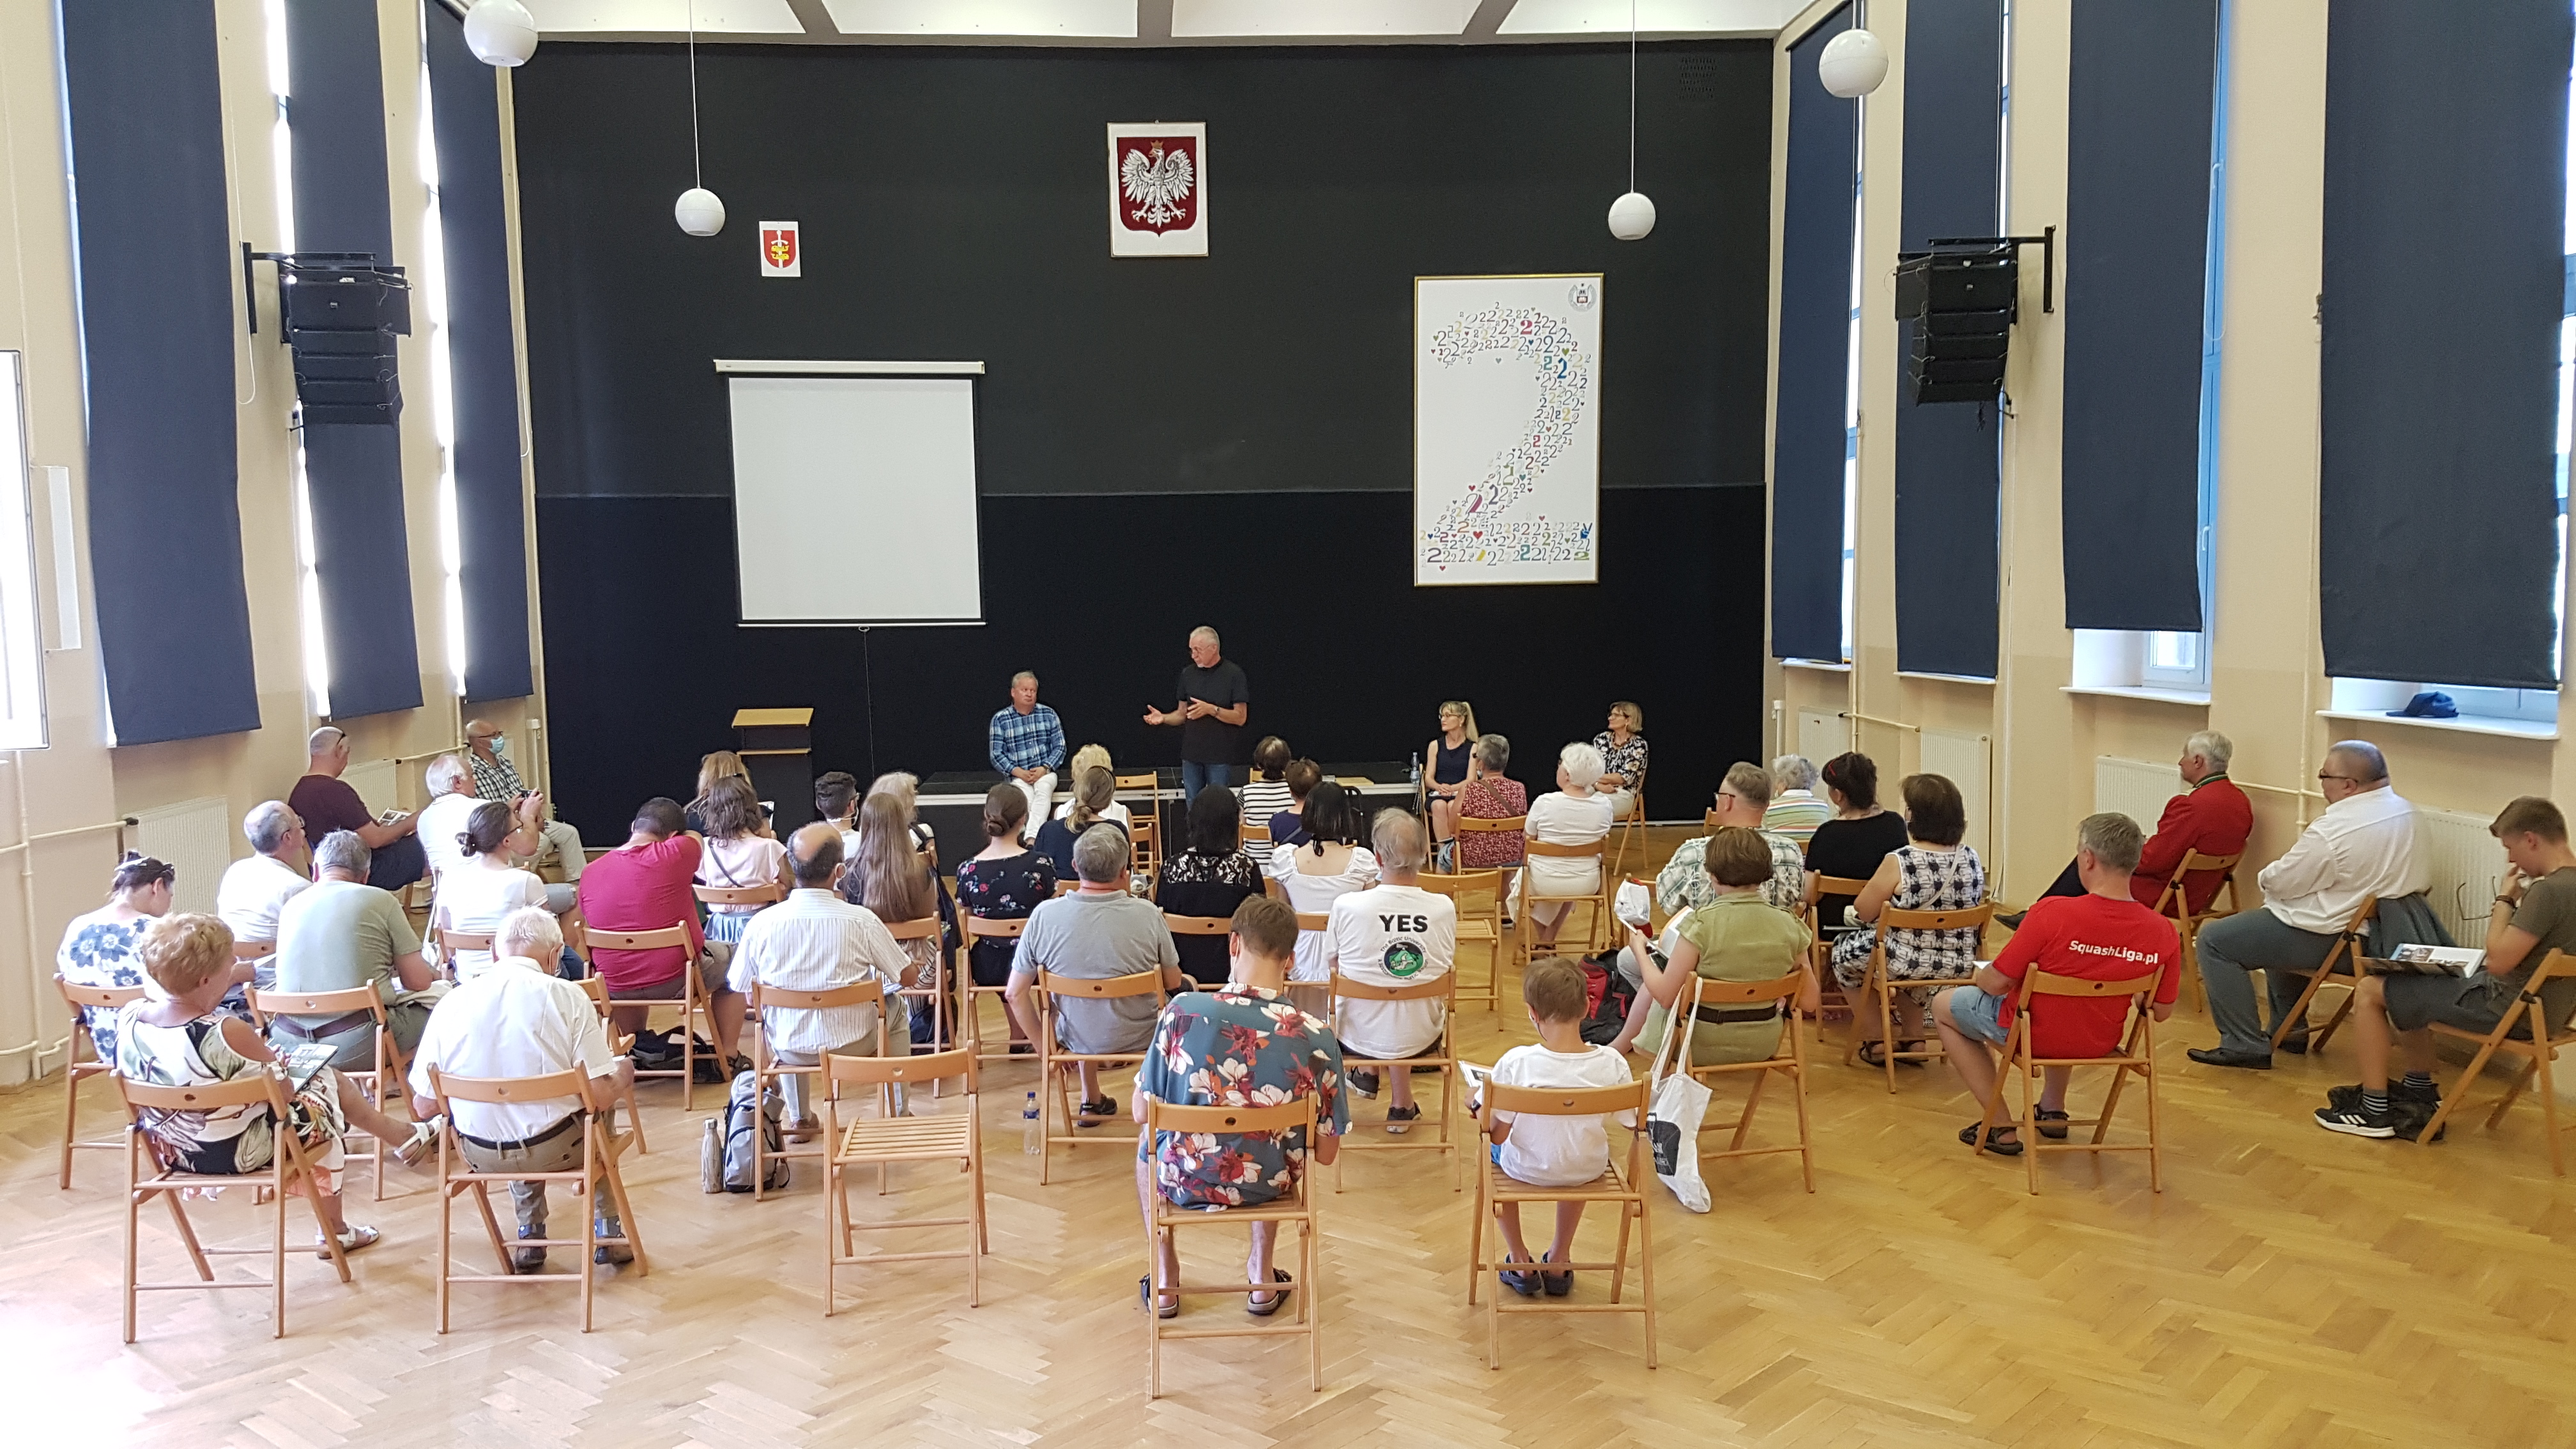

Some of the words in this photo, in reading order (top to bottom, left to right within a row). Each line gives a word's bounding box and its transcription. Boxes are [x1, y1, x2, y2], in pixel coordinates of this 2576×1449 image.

[1480, 312, 1485, 322] 2
[1487, 310, 1496, 321] 2
[1498, 310, 1504, 319] 2
[1516, 310, 1521, 319] 2
[1523, 310, 1529, 318] 2
[1534, 313, 1542, 323] 2
[1454, 321, 1462, 332] 2
[1464, 314, 1478, 328] 2
[1498, 319, 1508, 334] 2
[1509, 318, 1515, 326] 2
[1542, 316, 1550, 328] 2
[1448, 325, 1453, 338] 2
[1490, 326, 1497, 338] 2
[1511, 327, 1519, 337] 2
[1521, 320, 1532, 335] 2
[1534, 325, 1540, 335] 2
[1549, 320, 1556, 334] 2
[1438, 331, 1446, 346] 2
[1474, 330, 1478, 338] 2
[1482, 330, 1488, 339] 2
[1556, 328, 1567, 343] 2
[1567, 334, 1571, 342] 2
[1461, 338, 1468, 348] 2
[1478, 342, 1483, 351] 2
[1485, 340, 1492, 349] 2
[1494, 340, 1499, 348] 2
[1500, 337, 1510, 348] 2
[1510, 339, 1519, 349] 2
[1518, 337, 1526, 351] 2
[1535, 338, 1542, 351] 2
[1544, 335, 1553, 353] 2
[1572, 341, 1577, 351] 2
[1452, 342, 1459, 356] 2
[1524, 345, 1529, 355] 2
[1529, 349, 1533, 358] 2
[1554, 346, 1560, 356] 2
[1443, 348, 1451, 362] 2
[1535, 353, 1540, 364] 2
[1572, 354, 1583, 367] 2
[1585, 355, 1591, 363] 2
[1544, 356, 1552, 370] 2
[1557, 358, 1567, 378] 2
[1538, 365, 1542, 373] 2
[1580, 368, 1586, 376] 2
[1541, 372, 1551, 387] 2
[1549, 377, 1556, 390] 2
[1568, 371, 1577, 387] 2
[1580, 378, 1587, 388] 2
[1541, 387, 1547, 396] 2
[1573, 387, 1578, 396] 2
[1540, 397, 1547, 408] 2
[1549, 393, 1556, 403] 2
[1563, 390, 1572, 405] 2
[1572, 397, 1579, 411] 2
[1535, 409, 1543, 418] 2
[1550, 406, 1554, 422] 2
[1556, 411, 1561, 419] 2
[1562, 407, 1570, 420] 2
[1572, 413, 1579, 424] 2
[1537, 420, 1545, 433] 2
[1552, 424, 1558, 436] 2
[1562, 423, 1572, 434] 2
[1533, 435, 1540, 447] 2
[1544, 434, 1551, 447] 2
[1554, 434, 1562, 443] 2
[1518, 448, 1522, 459] 2
[1524, 442, 1531, 455] 2
[1549, 445, 1557, 457] 2
[1506, 453, 1514, 464] 2
[1535, 450, 1541, 463] 2
[1541, 456, 1549, 466] 2
[1526, 457, 1534, 469] 2
[1503, 464, 1514, 485] 2
[1532, 465, 1540, 478] 2
[1497, 471, 1501, 486] 2
[1514, 478, 1519, 489] 2
[1520, 483, 1525, 493] 2
[1489, 484, 1498, 505] 2
[1499, 487, 1508, 501] 2
[1466, 493, 1487, 514] 2
[1506, 499, 1512, 507] 2
[1456, 507, 1462, 516] 2
[1498, 505, 1505, 513] 2
[1464, 512, 1469, 521] 2
[1457, 521, 1469, 533] 2
[1471, 518, 1476, 527] 2
[1504, 523, 1510, 533] 2
[1513, 523, 1519, 532] 2
[1558, 523, 1564, 532] 2
[1573, 522, 1579, 530] 2
[1434, 527, 1440, 537] 2
[1491, 523, 1494, 536] 2
[1496, 523, 1502, 534] 2
[1521, 523, 1529, 535] 2
[1533, 523, 1540, 535] 2
[1420, 530, 1426, 540] 2
[1440, 532, 1448, 542] 2
[1459, 534, 1465, 542] 2
[1507, 533, 1515, 548] 2
[1542, 532, 1551, 546] 2
[1558, 533, 1563, 544] 2
[1572, 533, 1577, 542] 2
[1450, 540, 1457, 549] 2
[1466, 537, 1473, 548] 2
[1475, 539, 1483, 549] 2
[1498, 536, 1506, 546] 2
[1532, 537, 1537, 546] 2
[1551, 540, 1555, 553] 2
[1577, 540, 1584, 549] 2
[1586, 539, 1590, 551] 2
[1427, 548, 1442, 562] 2
[1443, 550, 1450, 562] 2
[1451, 553, 1456, 562] 2
[1459, 549, 1466, 562] 2
[1487, 551, 1496, 565] 2
[1498, 549, 1504, 562] 2
[1513, 550, 1519, 561] 2
[1521, 544, 1530, 561] 2
[1531, 548, 1541, 561] 2
[1542, 548, 1546, 560] 2
[1554, 547, 1561, 560] 2
[1563, 549, 1570, 560] 2
[1574, 551, 1589, 560] 2
[1548, 555, 1551, 564] 2
[1379, 915, 1428, 933] YES
[2069, 940, 2159, 965] SquashLiga.pl
